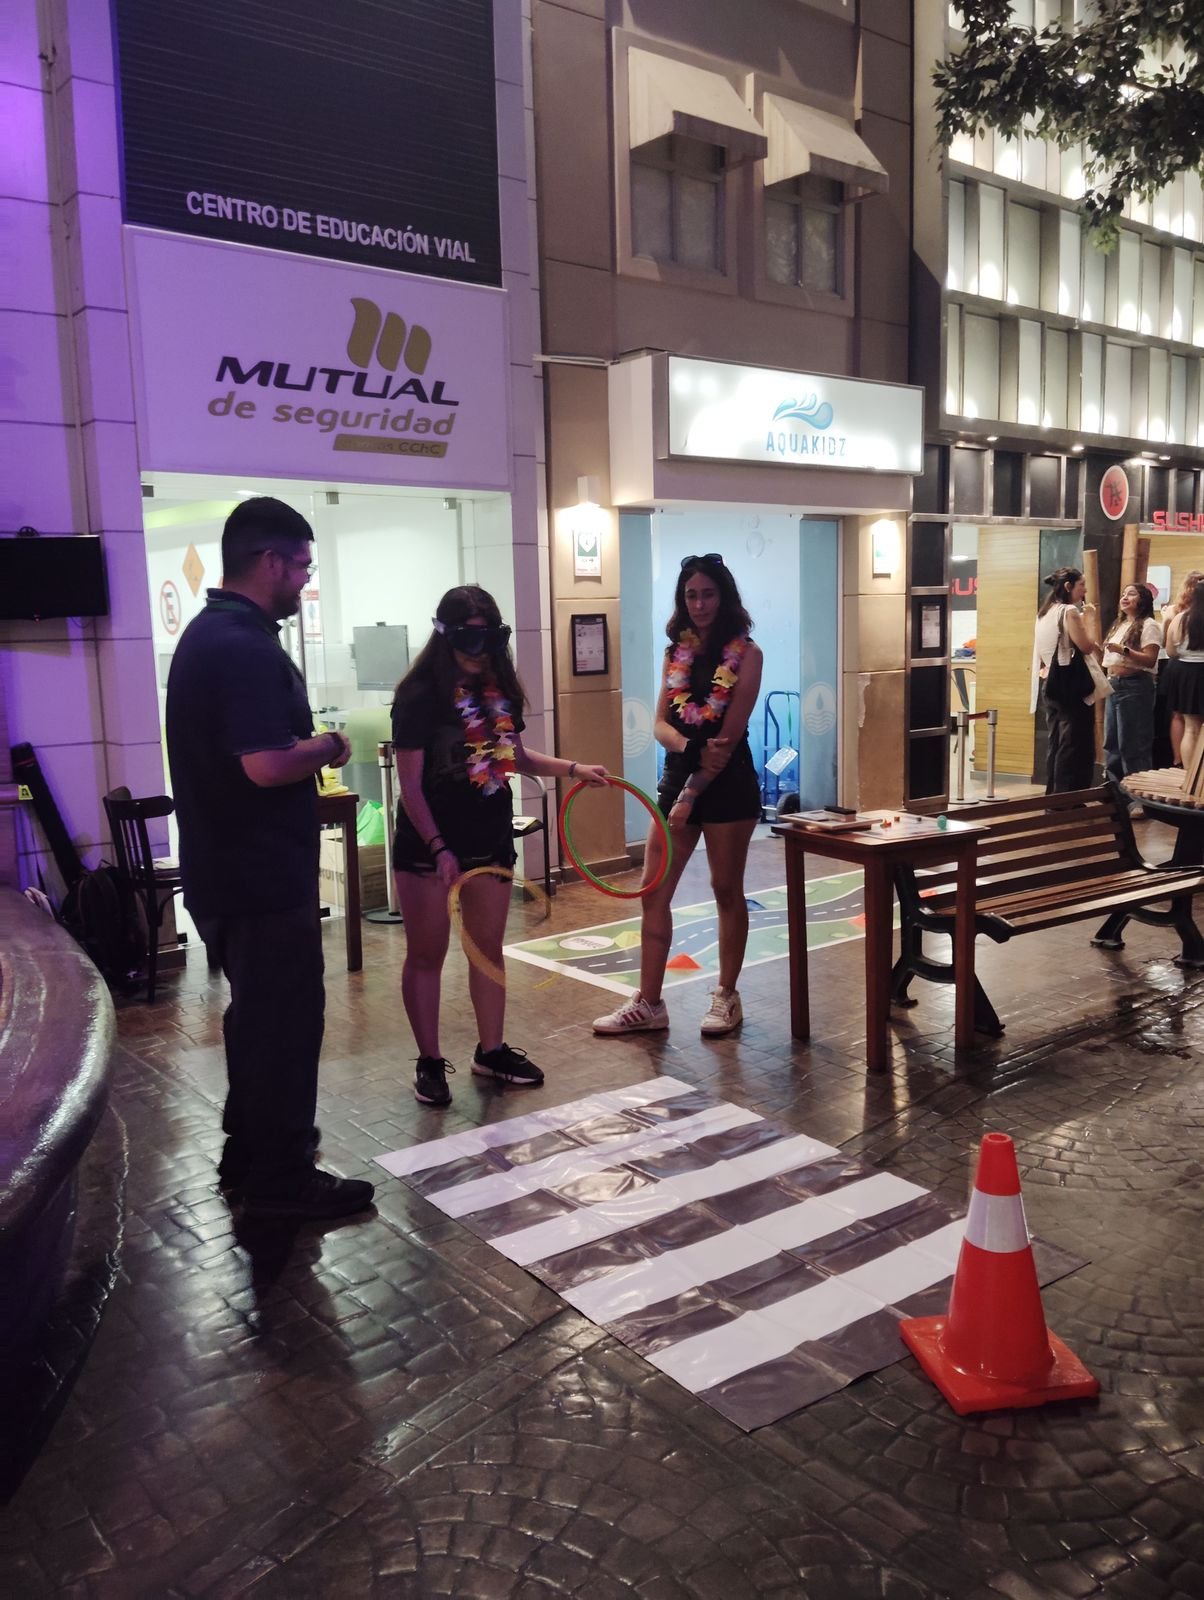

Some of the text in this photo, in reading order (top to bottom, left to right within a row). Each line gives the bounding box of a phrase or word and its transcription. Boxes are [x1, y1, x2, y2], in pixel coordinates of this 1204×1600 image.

[186, 191, 477, 264] CENTRO DE EDUCACIÓN VIAL
[215, 356, 460, 407] MUTUAL
[207, 390, 457, 436] de seguridad
[766, 431, 847, 457] AQUAKIDZ
